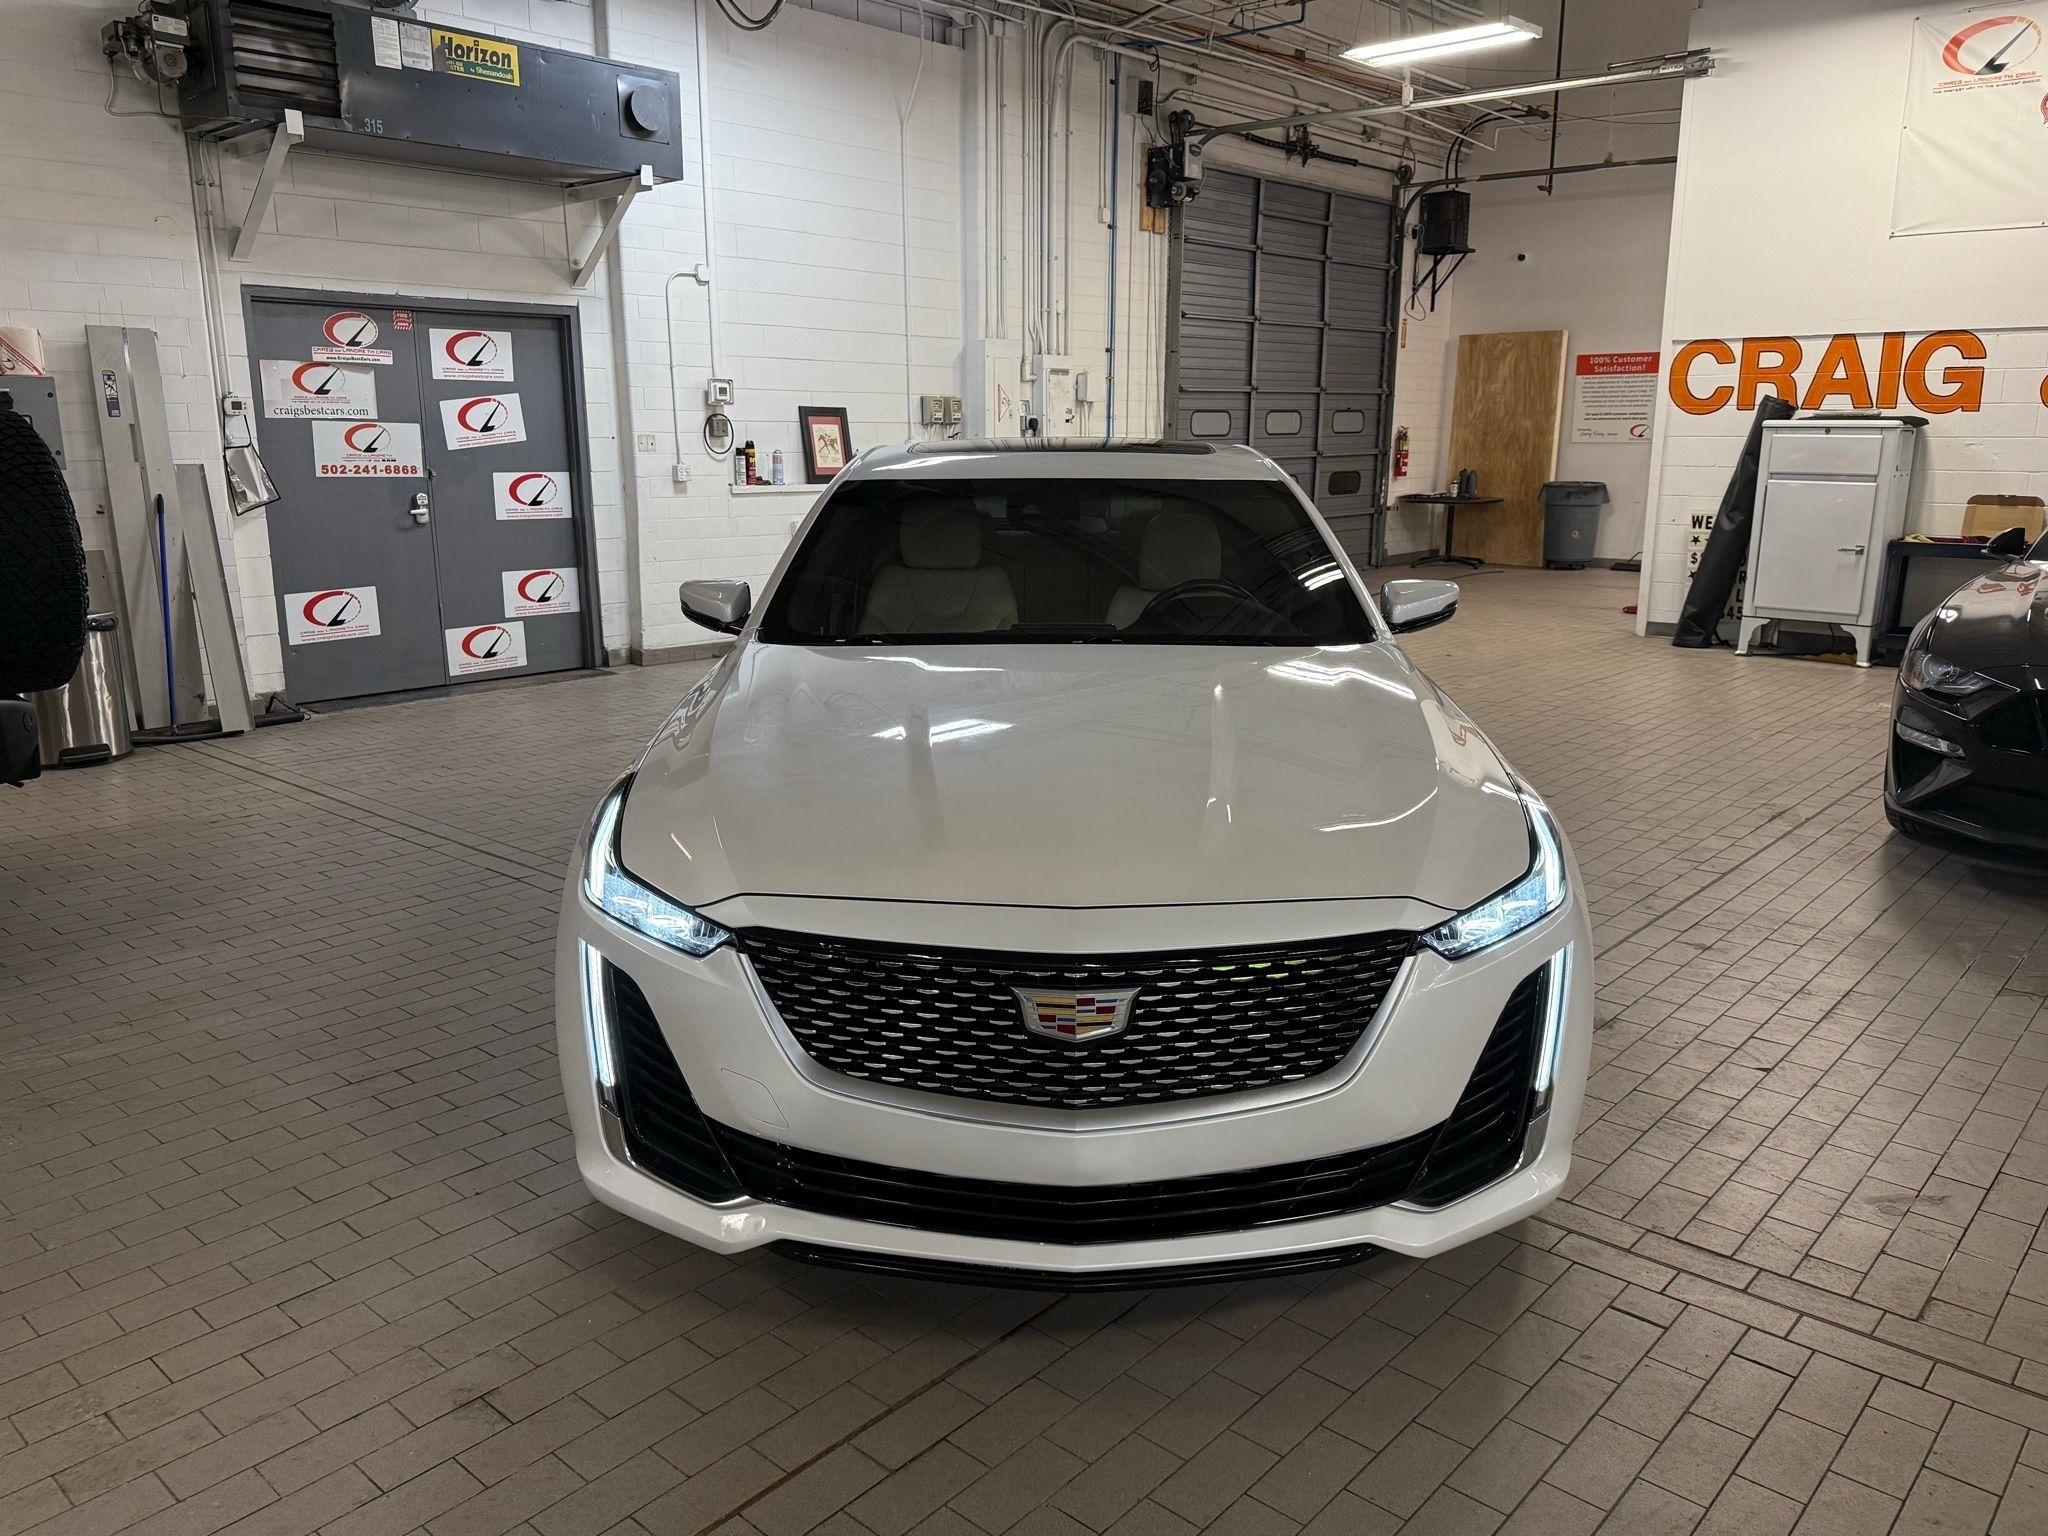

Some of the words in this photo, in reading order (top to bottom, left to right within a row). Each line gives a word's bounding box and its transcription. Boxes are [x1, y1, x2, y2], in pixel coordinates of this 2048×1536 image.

[440, 35, 512, 68] Horizon
[475, 66, 513, 79] Shenandoah
[364, 118, 383, 134] 315
[1589, 356, 1610, 364] 100%
[1612, 355, 1652, 363] Customer
[1593, 364, 1646, 373] Satisfaction!
[1669, 329, 1987, 416] CRAIG
[273, 405, 369, 417] craigsbestcars.com
[321, 464, 418, 475] 502-241-6868
